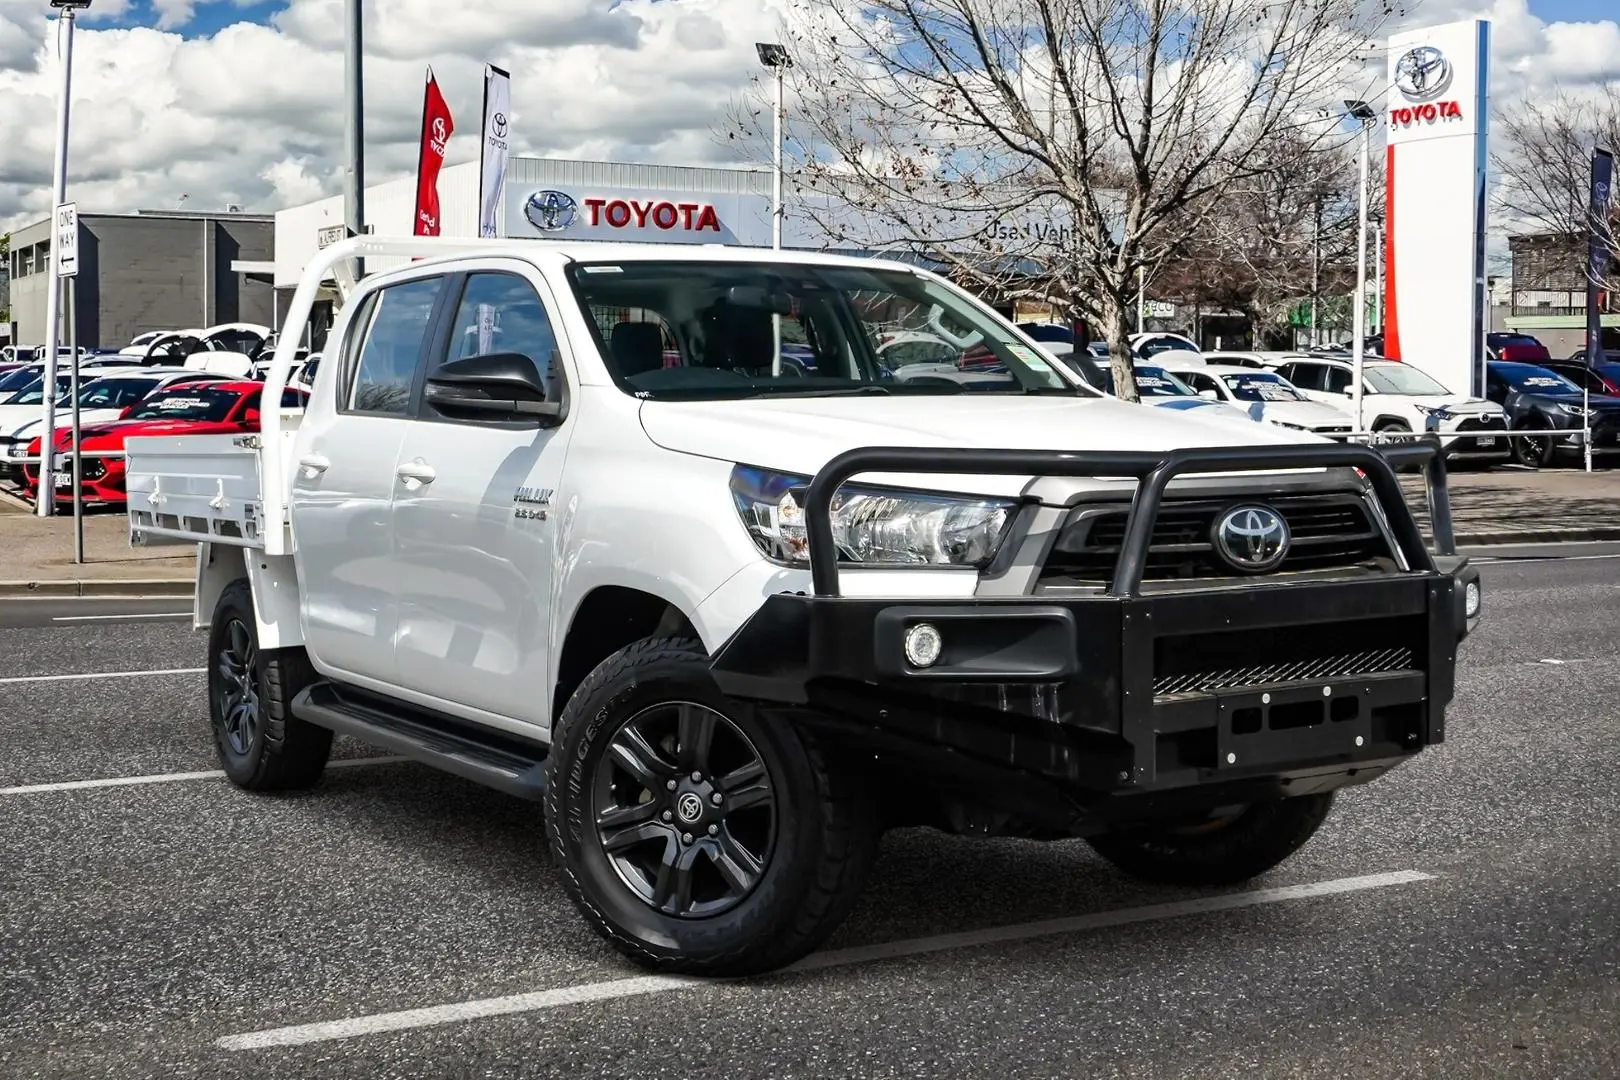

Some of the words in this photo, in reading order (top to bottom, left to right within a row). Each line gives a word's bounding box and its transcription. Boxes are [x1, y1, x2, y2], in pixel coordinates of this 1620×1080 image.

[1389, 100, 1462, 126] TOYOTA
[488, 136, 508, 151] TOYOTA
[59, 209, 74, 228] ONE
[584, 198, 721, 232] TOYOTA
[59, 231, 75, 249] WAY
